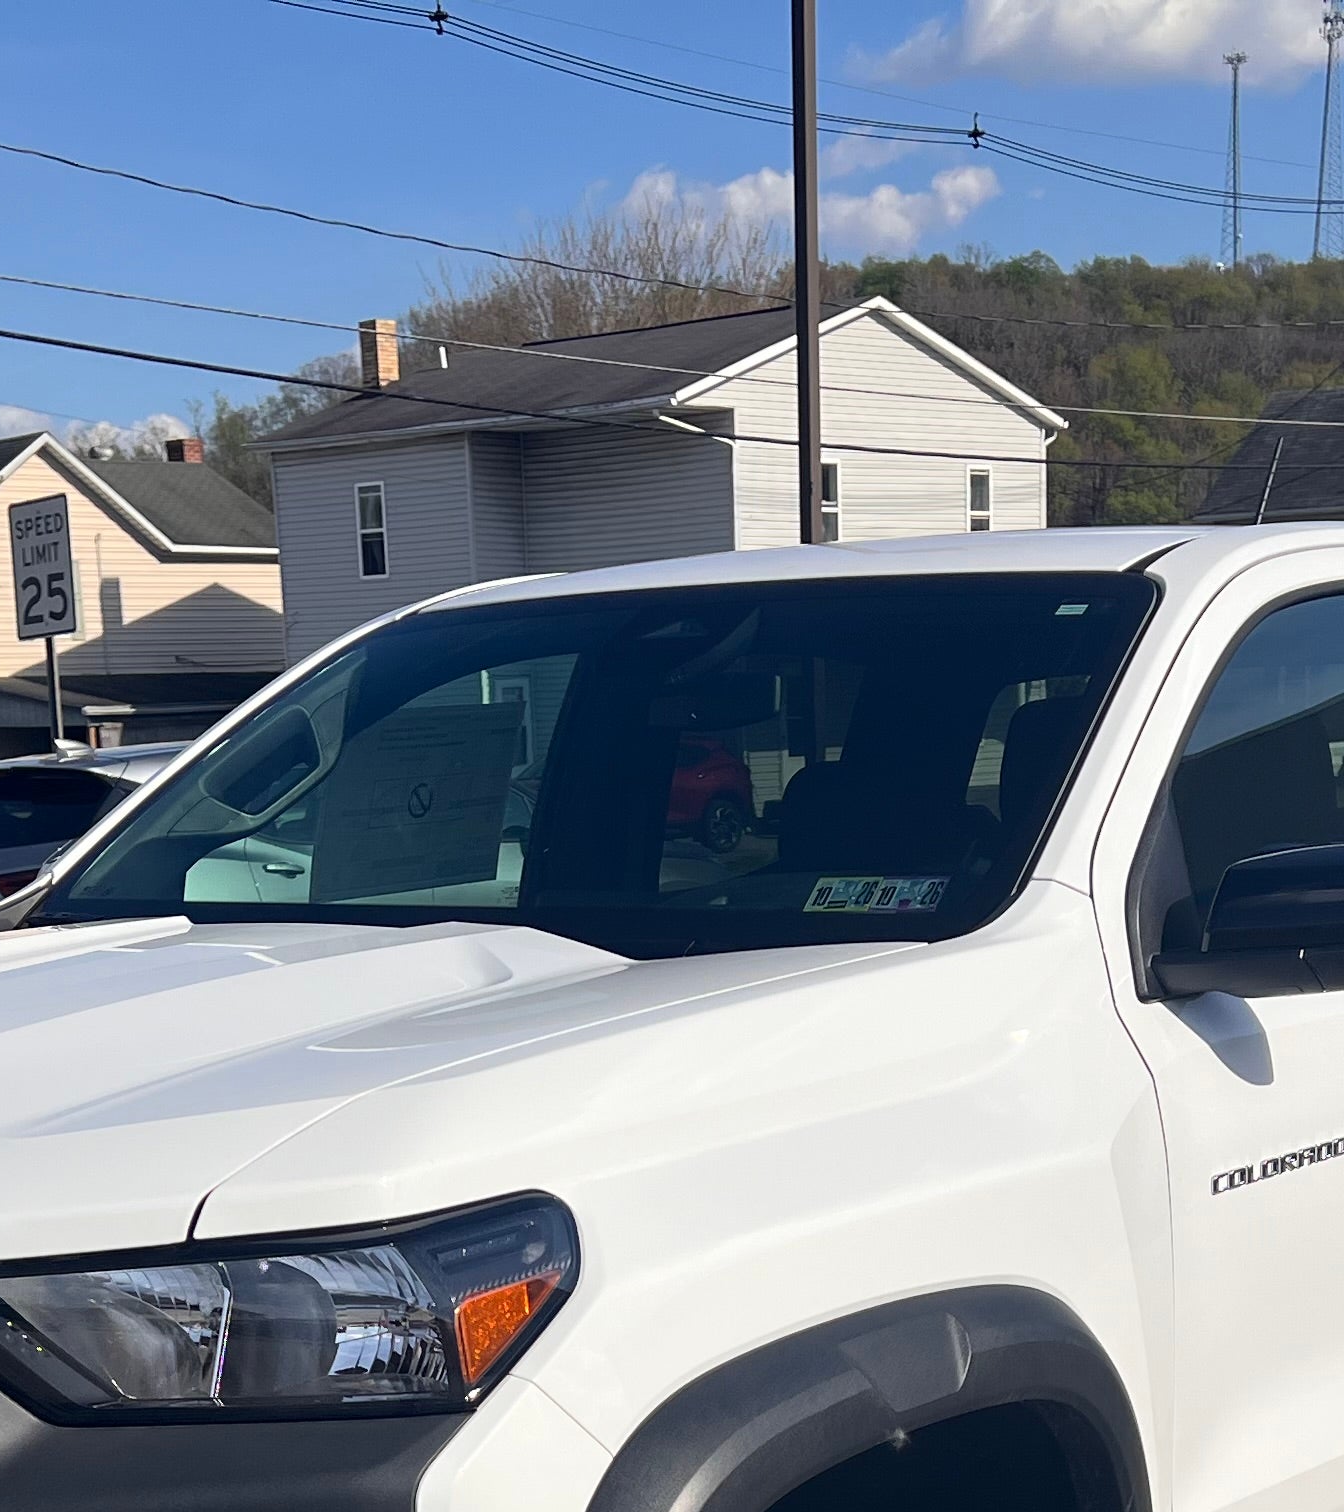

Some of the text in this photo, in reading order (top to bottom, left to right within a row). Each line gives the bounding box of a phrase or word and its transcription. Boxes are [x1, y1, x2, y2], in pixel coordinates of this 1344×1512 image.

[14, 511, 64, 541] SPEED
[21, 541, 60, 567] LIMIT
[21, 571, 68, 626] 25
[811, 880, 880, 907] 10 26
[875, 880, 945, 906] 10 26
